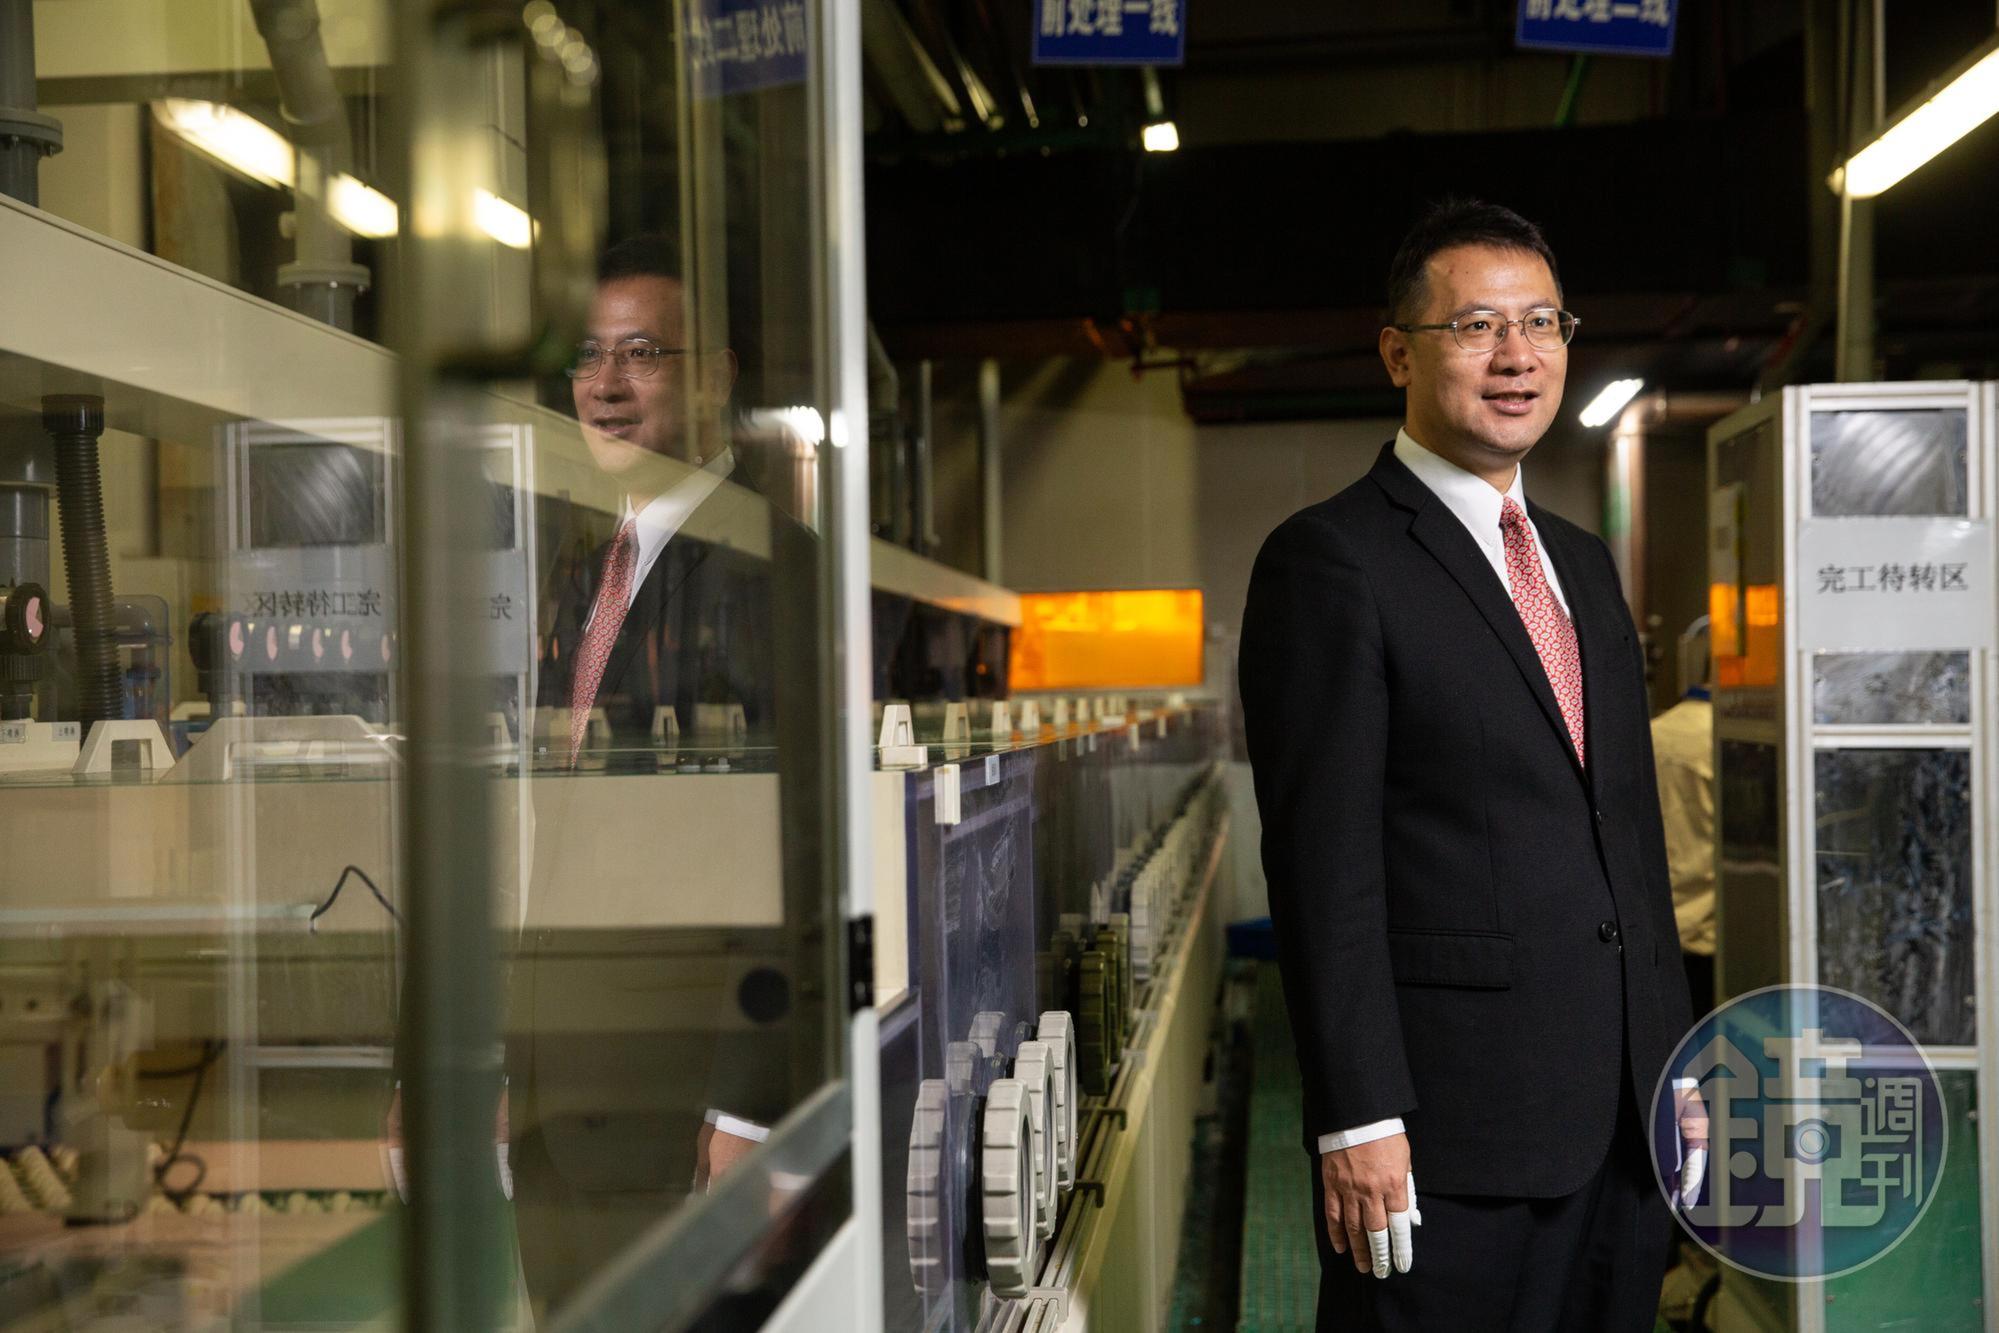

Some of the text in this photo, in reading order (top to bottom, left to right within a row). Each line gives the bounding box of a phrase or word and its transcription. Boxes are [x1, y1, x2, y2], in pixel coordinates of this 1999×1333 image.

[1817, 561, 1969, 594] 完工待转区
